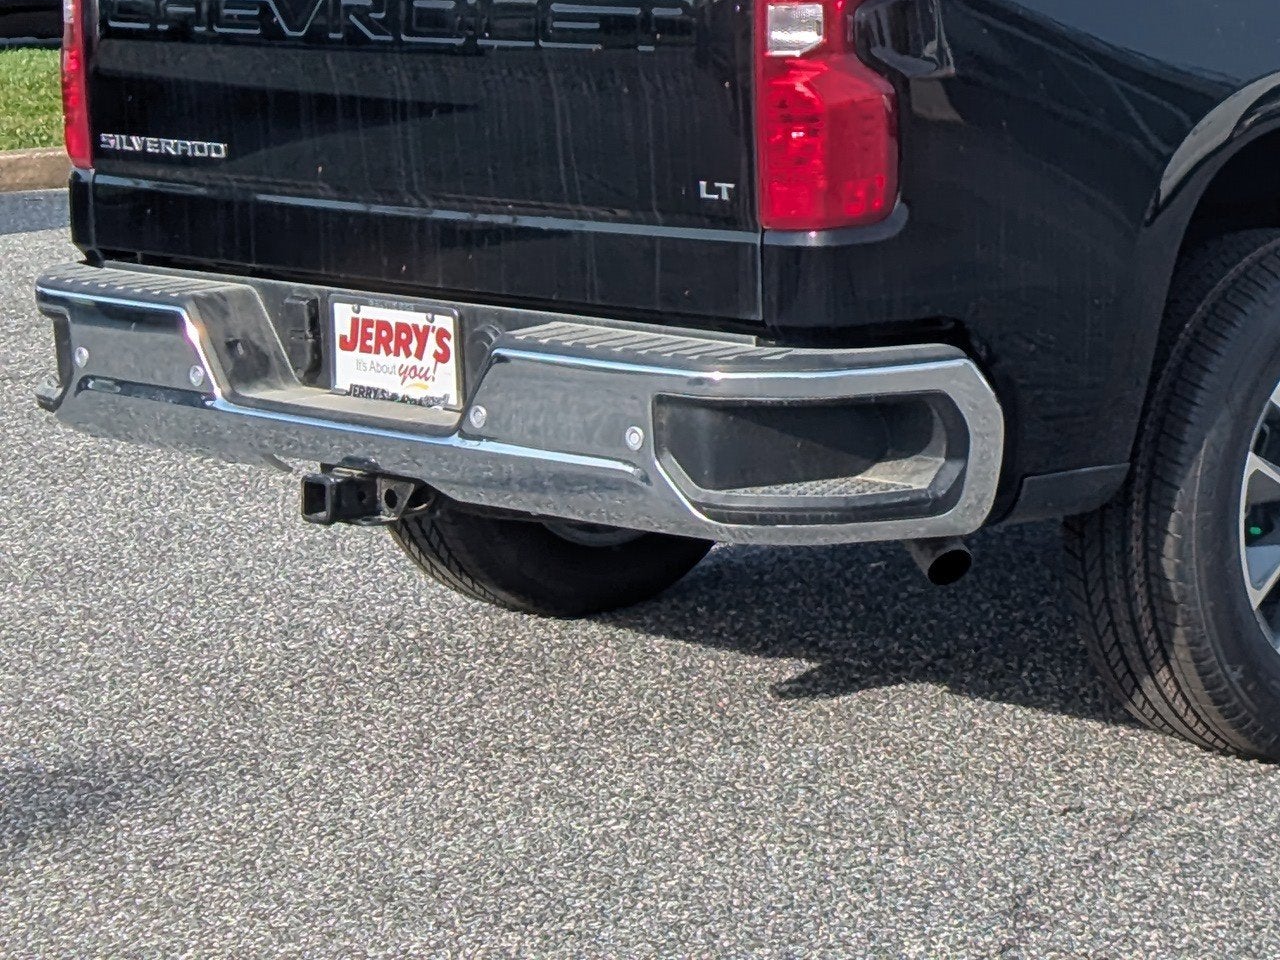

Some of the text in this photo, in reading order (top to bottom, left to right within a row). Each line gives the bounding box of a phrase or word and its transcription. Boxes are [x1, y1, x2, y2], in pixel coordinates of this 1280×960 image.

[99, 133, 227, 158] SILVERADO
[698, 181, 736, 201] LT
[339, 317, 452, 365] JERRY'S
[369, 361, 397, 376] About
[398, 360, 437, 386] you!
